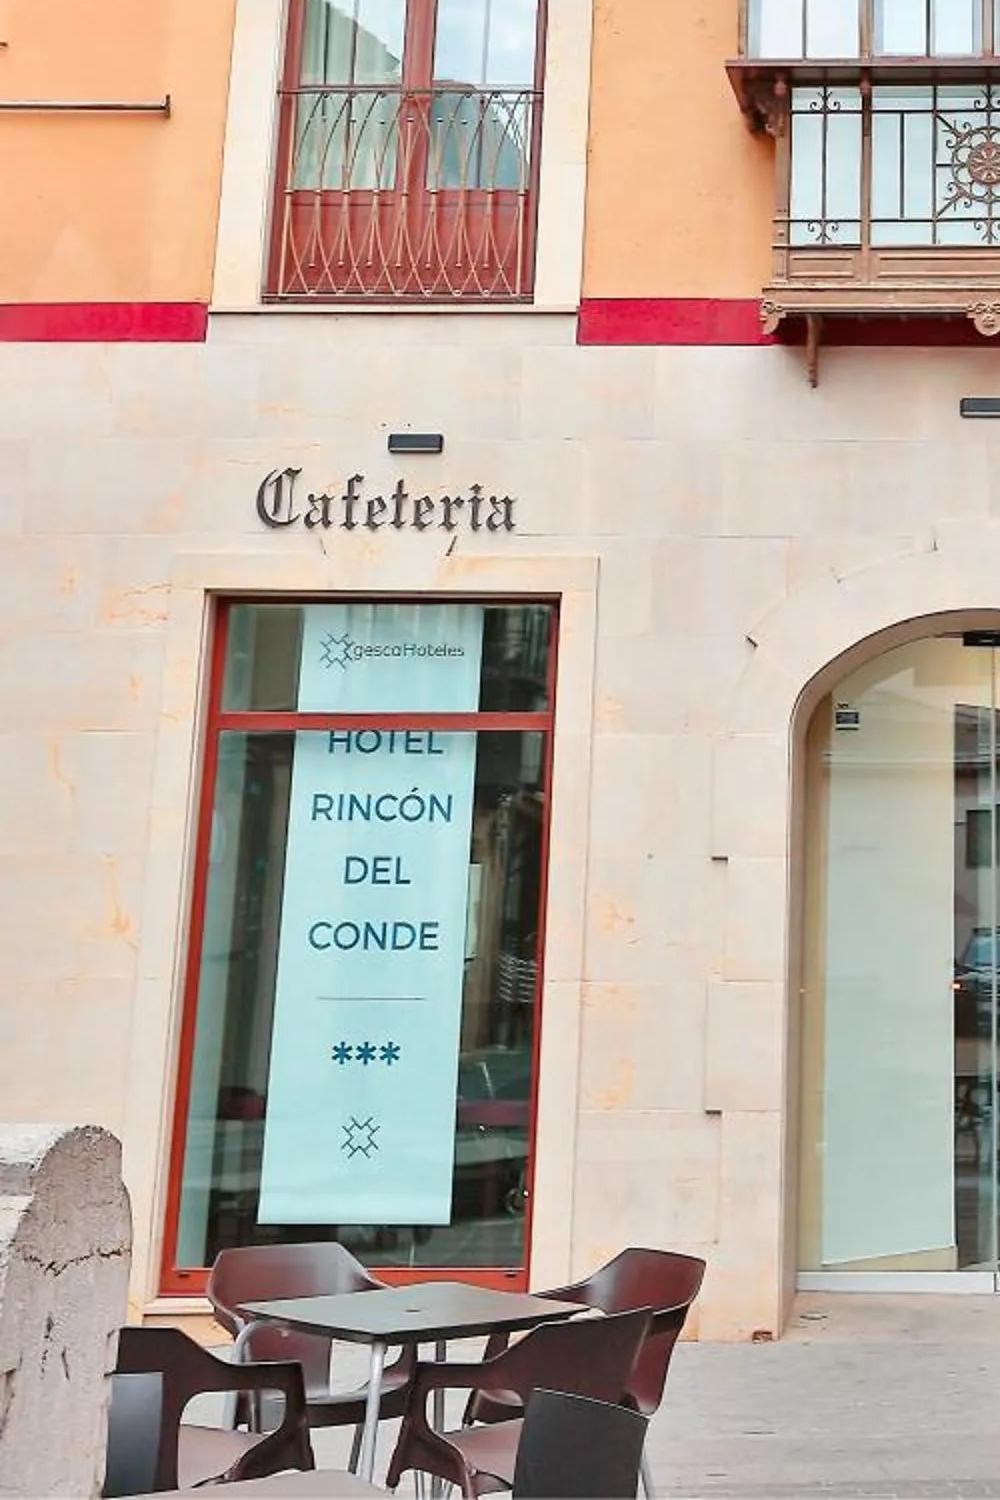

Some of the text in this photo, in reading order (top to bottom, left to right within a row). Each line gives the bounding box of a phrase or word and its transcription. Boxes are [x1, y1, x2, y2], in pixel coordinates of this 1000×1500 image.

[256, 467, 516, 533] Cafeteria
[353, 643, 465, 660] gescaHoteles
[328, 730, 444, 754] HOTEL
[311, 787, 453, 822] RINCÓN
[343, 856, 411, 884] DEL
[308, 921, 439, 950] CONDE
